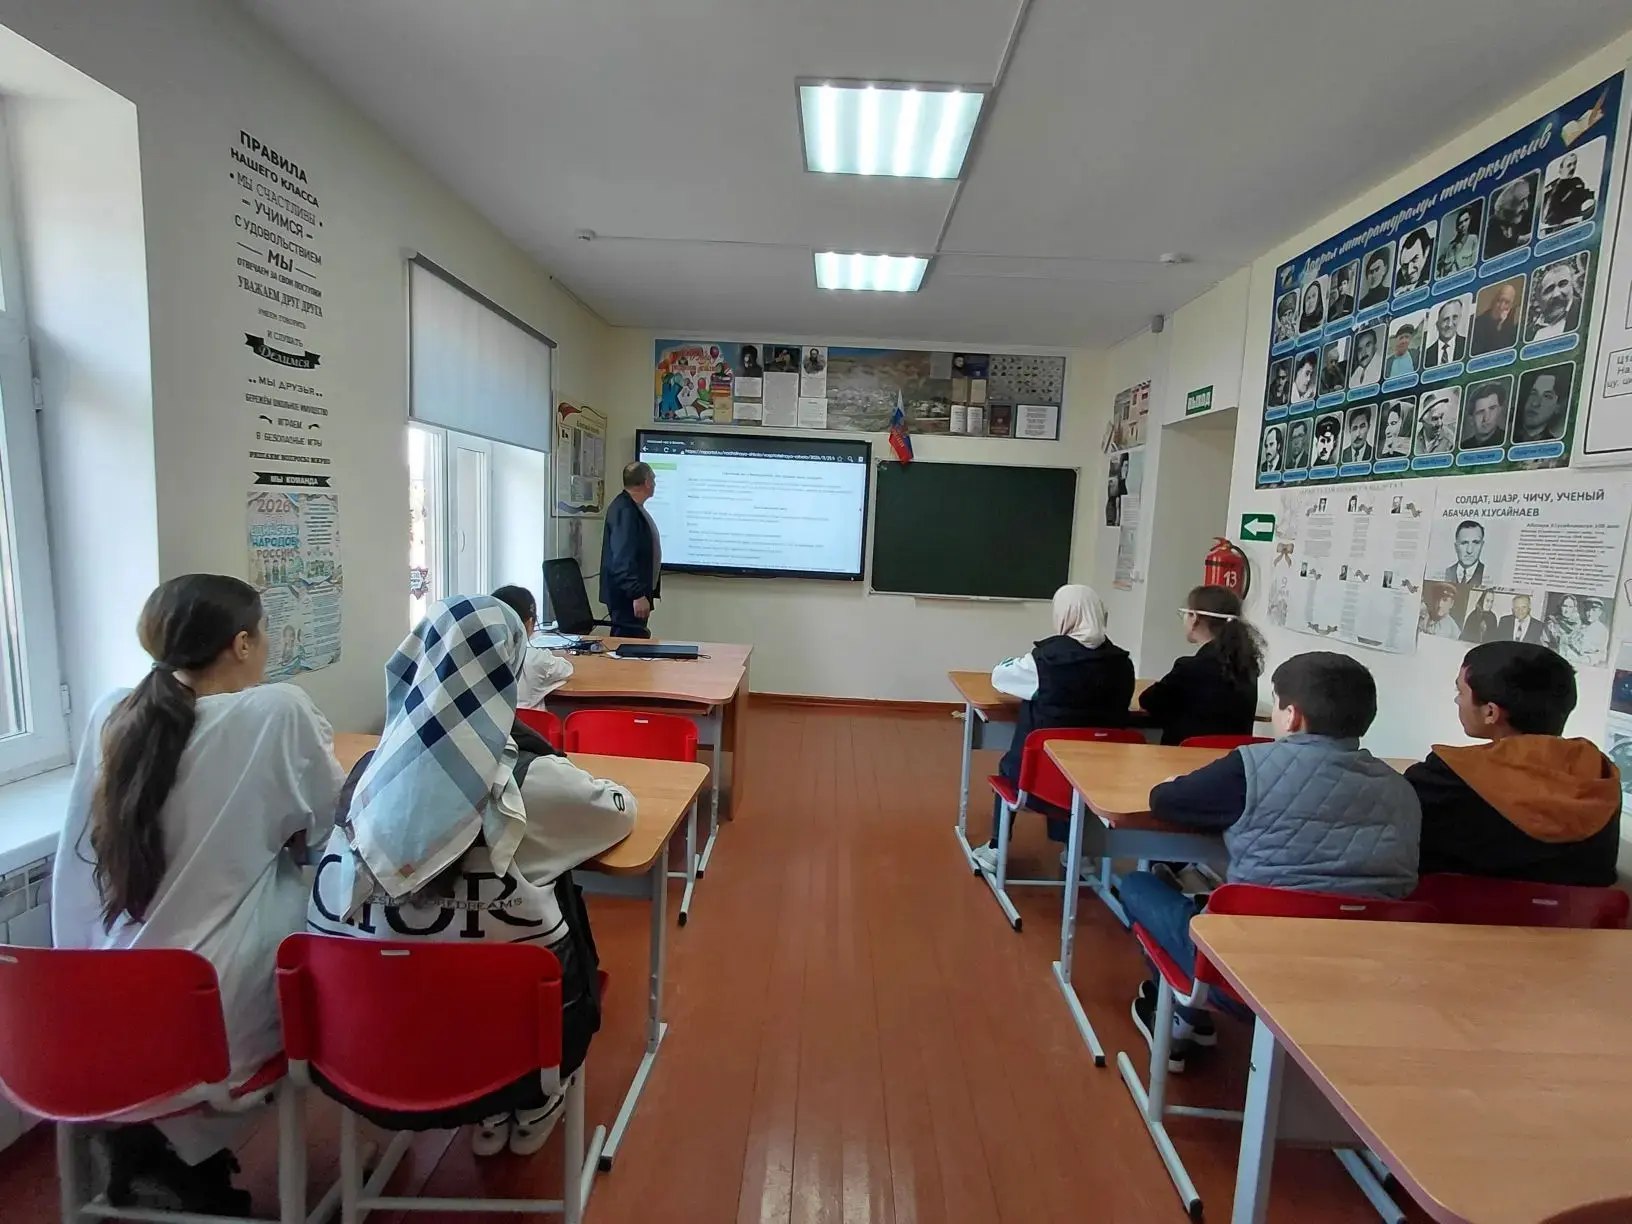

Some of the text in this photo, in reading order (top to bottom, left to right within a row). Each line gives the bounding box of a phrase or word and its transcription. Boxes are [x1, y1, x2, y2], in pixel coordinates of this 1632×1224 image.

[240, 129, 308, 184] ПРАВИЛА
[230, 147, 320, 208] НАШЕГО КЛАССА
[237, 171, 316, 226] МЫ СЧАСТЛИВЫ
[254, 199, 304, 239] УЧИМСЯ
[234, 214, 322, 265] С УДОВОЛЬСТВИЕМ
[267, 249, 293, 272] МЫ
[237, 257, 322, 298] ОТВЕЧАЕМ ЗА СВОИ ПОСТУПКИ
[237, 275, 323, 318] УВАЖАЕМ ДРУГ ДРУГА
[258, 376, 315, 396] МЫ ДРУЗЬЯ
[277, 417, 303, 429] ИГРАЕМ
[286, 476, 319, 485] КОМАНДА
[257, 499, 292, 513] 2026
[1455, 488, 1605, 505] СОЛДАТ, ШАЭР, ЧИЧУ, УЧЕНЫЙ
[1442, 508, 1479, 518] АБАЧАРА
[252, 537, 298, 547] НАРОДОВ
[256, 548, 295, 560] РОССИИ
[1223, 570, 1237, 588] 13
